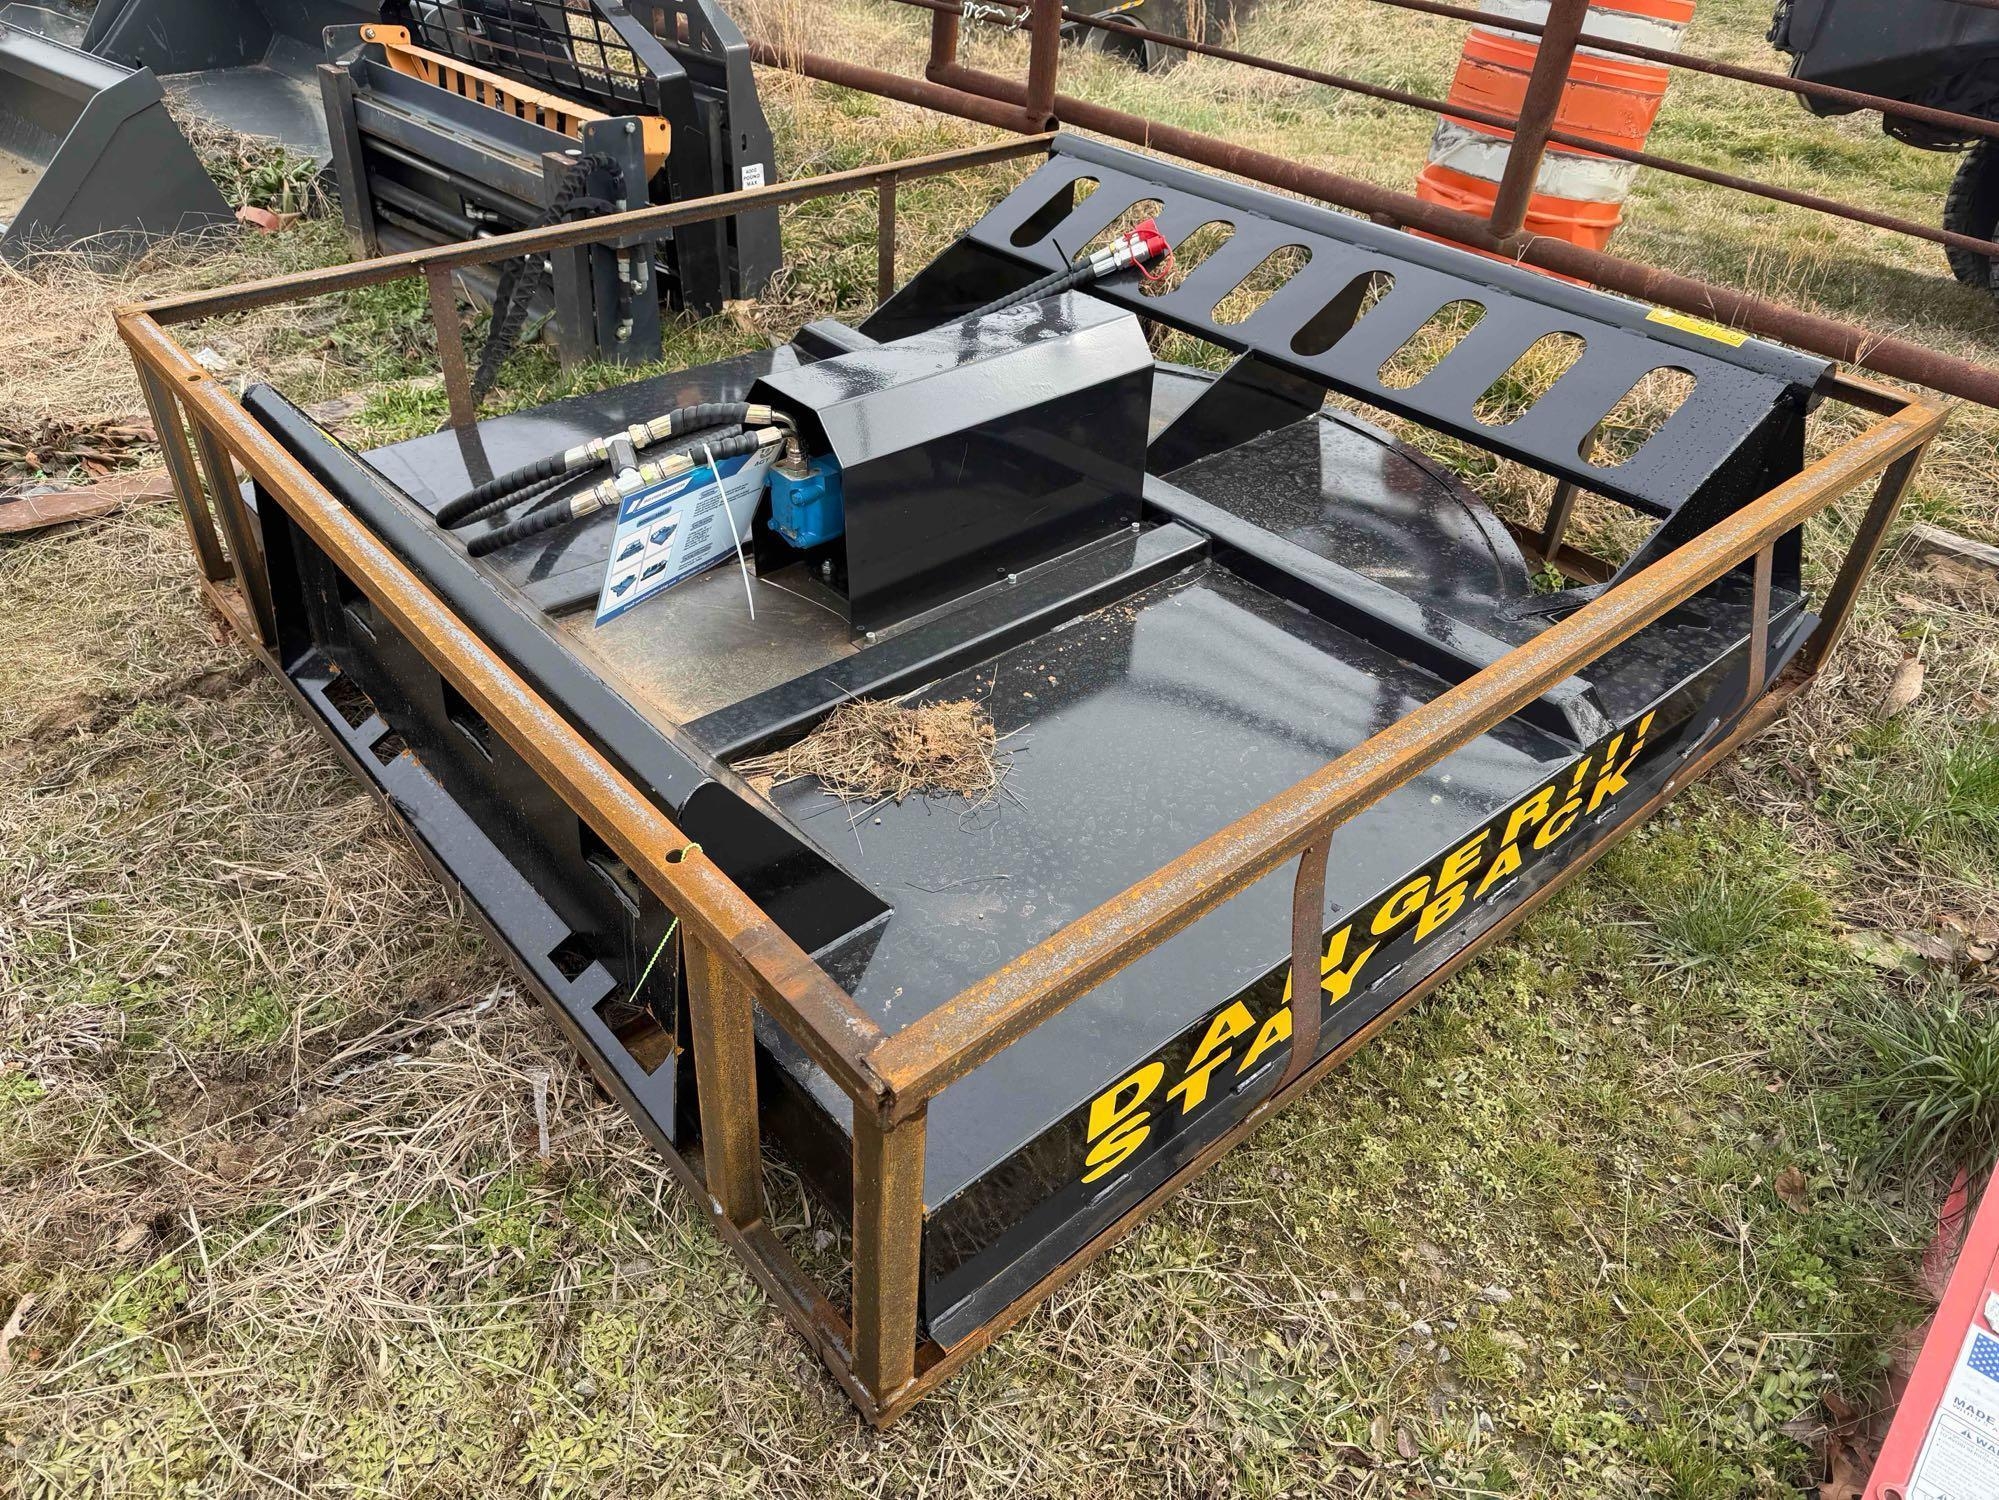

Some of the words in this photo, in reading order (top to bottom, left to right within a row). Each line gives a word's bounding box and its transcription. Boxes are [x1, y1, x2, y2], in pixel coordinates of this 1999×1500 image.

[1082, 941, 1381, 1183] STAY
[1413, 751, 1640, 944] BACK
[1954, 1397, 1995, 1425] MADE
[1976, 1437, 1999, 1456] WA
